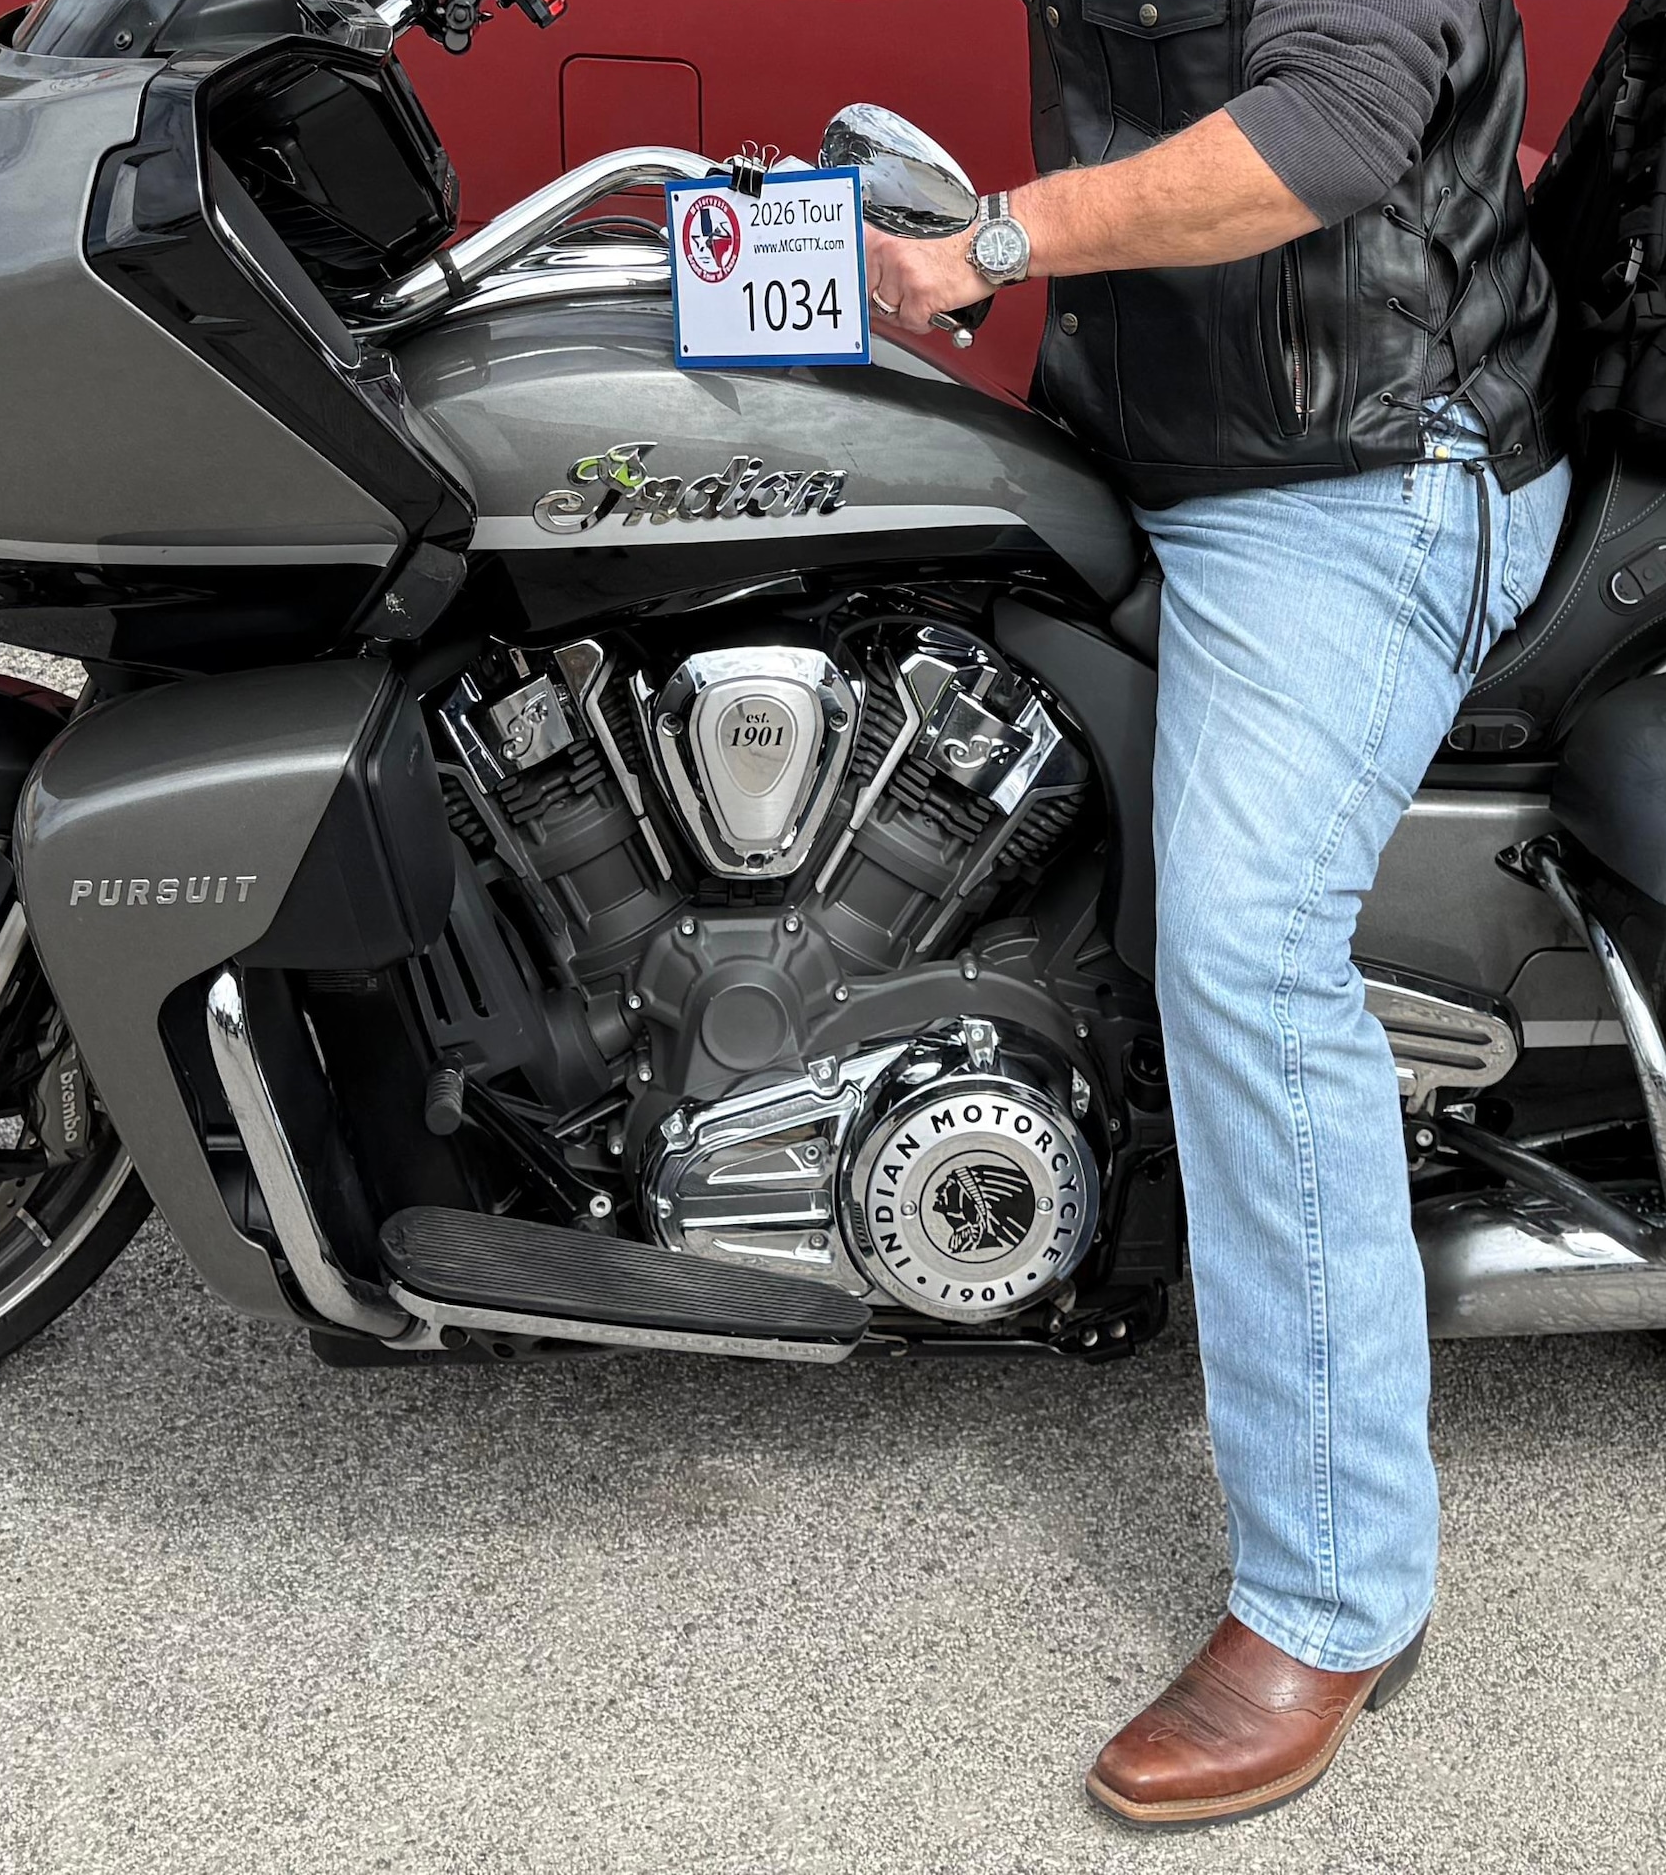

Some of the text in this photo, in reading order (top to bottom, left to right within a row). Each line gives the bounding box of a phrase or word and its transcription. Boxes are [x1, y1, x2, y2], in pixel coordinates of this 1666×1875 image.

[750, 199, 844, 226] 2026 Tour
[753, 237, 845, 254] www.MCGTTX.com
[742, 278, 842, 332] 1034
[533, 441, 848, 535] Indian
[745, 712, 770, 724] est.
[730, 726, 784, 747] 1901
[69, 875, 257, 906] PURSUIT
[60, 1068, 81, 1142] brembo
[875, 1104, 1079, 1269] INDIAN MOTORCYCLE
[940, 1281, 1016, 1303] 1901
